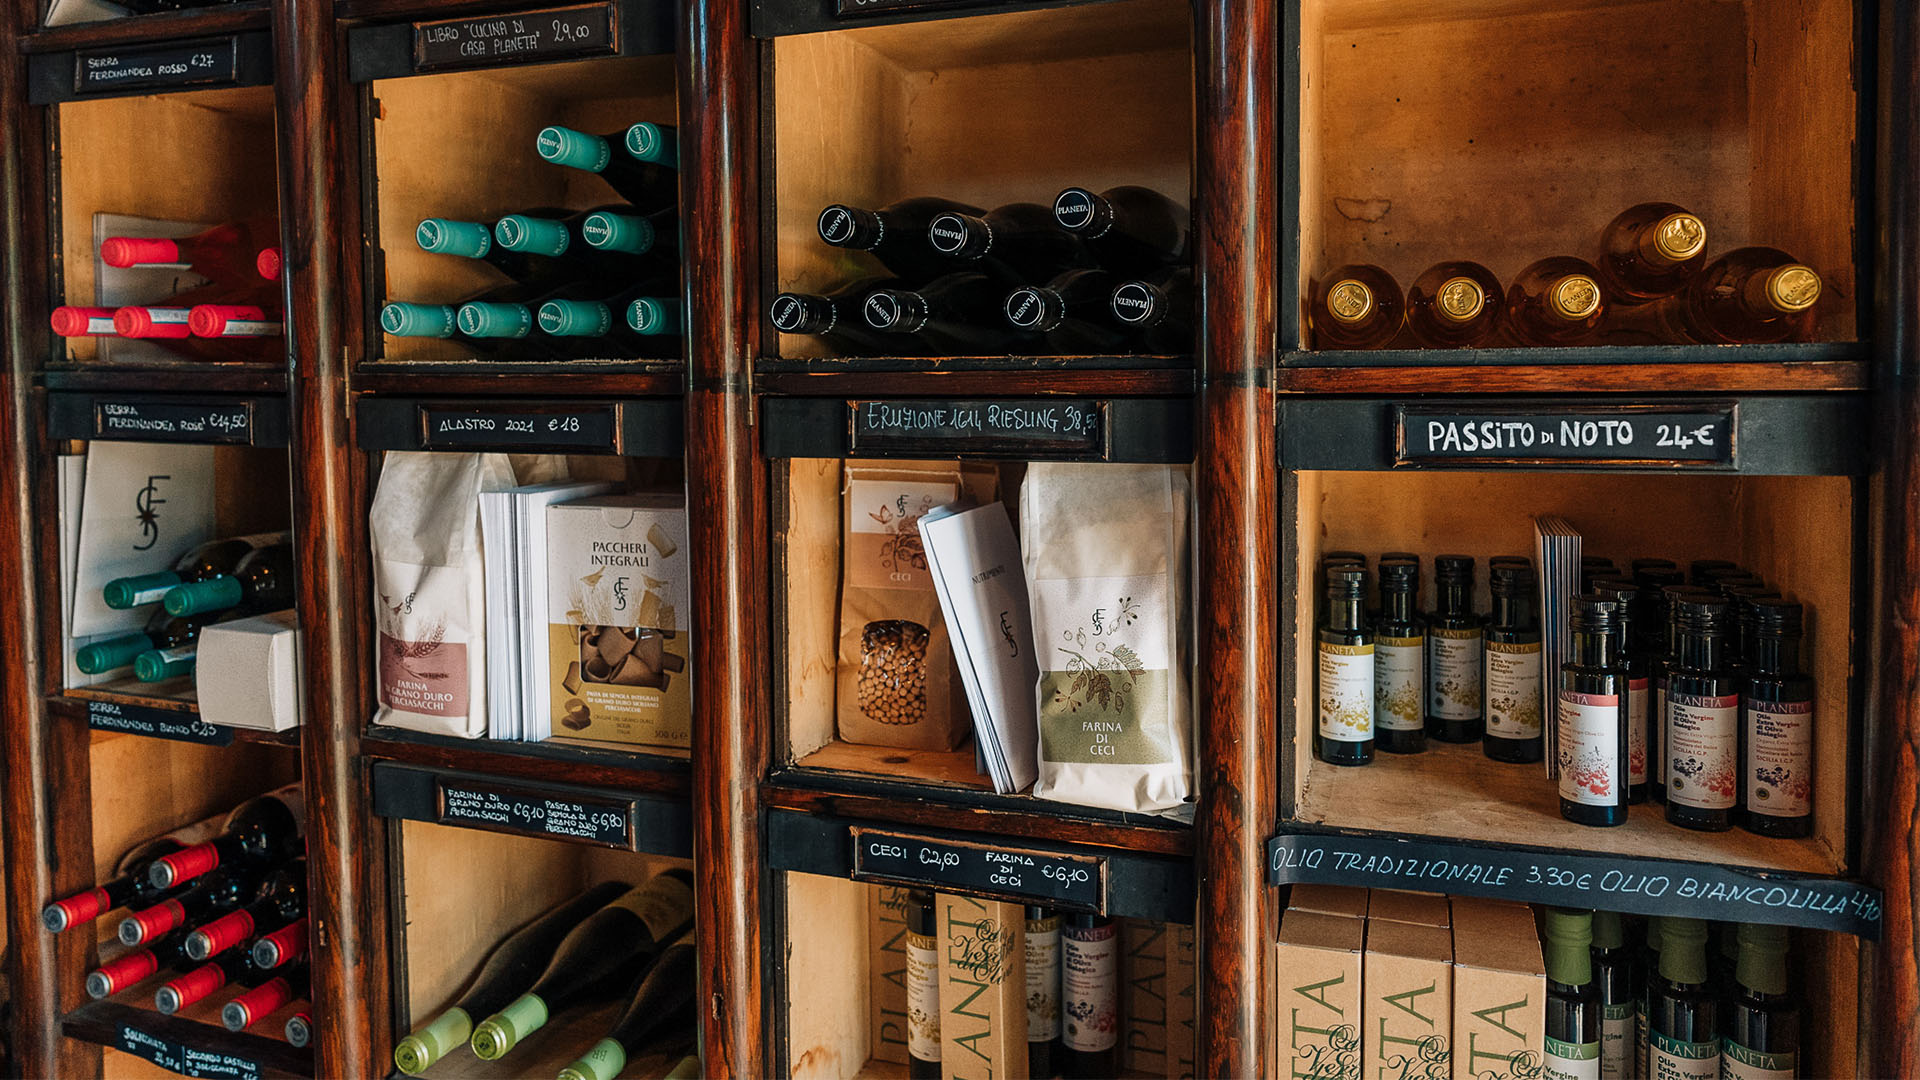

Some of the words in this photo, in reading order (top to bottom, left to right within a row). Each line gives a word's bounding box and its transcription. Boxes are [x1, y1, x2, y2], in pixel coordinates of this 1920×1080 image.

[427, 27, 459, 43] LIBRO
[464, 21, 508, 38] "CUCINA
[514, 20, 525, 34] DI
[552, 19, 590, 42] 29,00
[460, 40, 486, 56] CASA
[494, 31, 540, 55] PLANETA"
[88, 57, 118, 68] SERRA
[191, 54, 214, 68] €27
[89, 68, 152, 80] FERDINANDEA
[158, 64, 188, 75] ROSSO
[1058, 204, 1088, 215] PLANETA
[826, 211, 847, 238] PLANETA
[934, 227, 962, 240] PLANETA
[1012, 294, 1036, 322] PLANETA
[1117, 296, 1148, 310] PLANETA
[776, 301, 798, 326] PLANETA
[869, 298, 892, 324] PLANETA
[108, 417, 176, 432] FERDINANDEA
[210, 413, 247, 433] €14,50
[868, 402, 947, 431] ERUZIONE
[950, 408, 982, 432] 1614
[988, 404, 1059, 433] RIESLING
[439, 418, 496, 432] ALASTRO
[505, 419, 535, 433] 2021
[1541, 431, 1554, 444] DI
[1560, 420, 1633, 447] NOTO
[1656, 424, 1715, 450] 24€
[592, 541, 647, 554] PACCHERI
[591, 555, 649, 568] INTEGRALI
[890, 572, 912, 582] CECI
[391, 686, 421, 700] GRANO
[423, 692, 454, 702] DURO
[1674, 693, 1722, 708] PLANETA
[90, 702, 122, 716] SERRA
[1756, 701, 1806, 714] PLANETA
[90, 714, 154, 732] FERDINANDEA
[1082, 721, 1123, 733] FARINA
[1096, 734, 1108, 744] DI
[1090, 745, 1115, 756] CECI
[448, 789, 484, 800] FARINA
[489, 793, 500, 802] DI
[448, 798, 481, 808] GRANO
[484, 802, 511, 812] DURO
[545, 800, 570, 812] PASTA
[573, 804, 583, 812] DI
[514, 802, 545, 823] €6,10
[579, 813, 586, 821] DI
[547, 818, 577, 828] GRANO
[870, 843, 907, 859] CECI
[920, 848, 960, 872] €2,60
[986, 852, 1034, 866] FARINA
[1000, 866, 1014, 874] DI
[1041, 864, 1089, 888] €6,10
[1273, 846, 1324, 872] OLIO
[1333, 851, 1514, 886] TRADIZIONALE
[1600, 870, 1670, 897] OLIO
[1676, 878, 1847, 914] BIANCOLILLA
[1658, 1036, 1718, 1059] PLANETA
